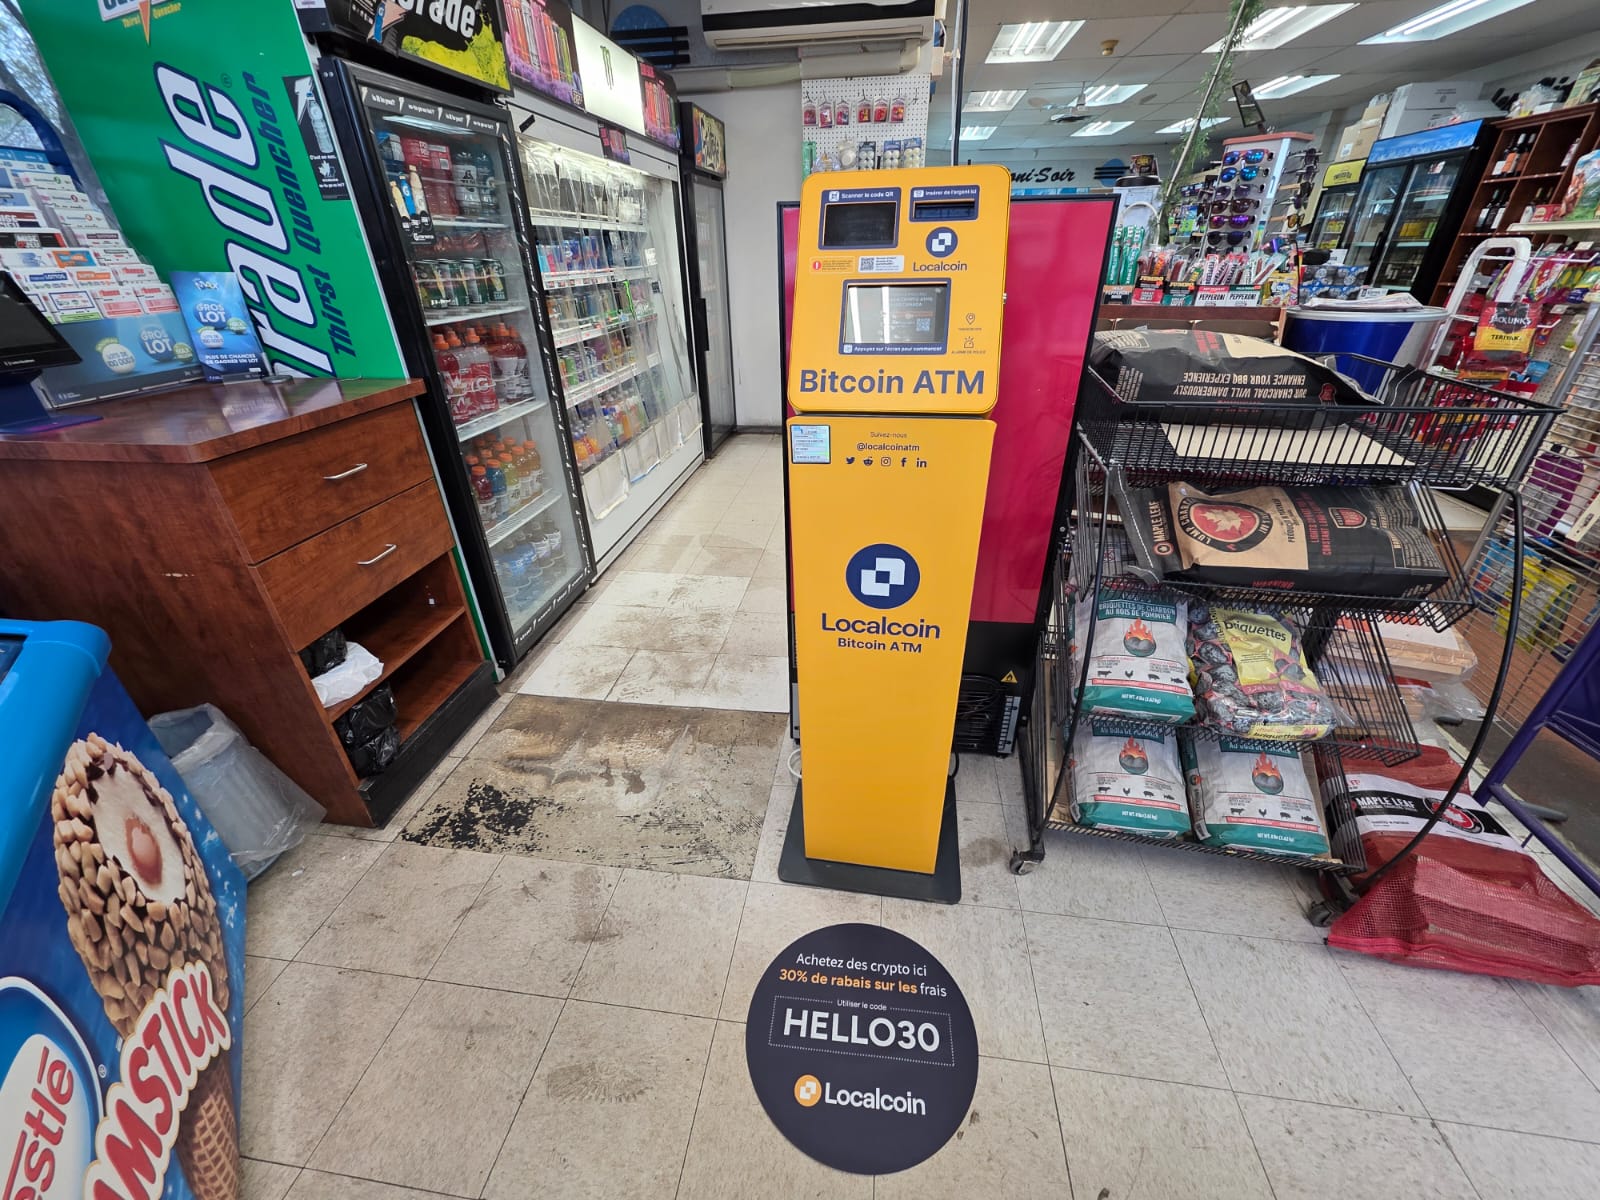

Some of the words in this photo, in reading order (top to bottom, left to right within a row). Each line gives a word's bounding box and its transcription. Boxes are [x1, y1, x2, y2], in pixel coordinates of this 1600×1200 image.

[242, 71, 321, 255] Quencher
[154, 61, 338, 378] rade
[912, 261, 968, 272] Localcoin
[1199, 293, 1226, 301] PEPPERONI
[196, 303, 225, 312] GROS
[306, 264, 357, 357] Thirst
[198, 311, 226, 323] LOT
[140, 328, 168, 341] GROS
[144, 338, 173, 354] LOT
[800, 368, 904, 393] Bitcoin
[912, 369, 985, 394] ATM
[1183, 372, 1231, 384] EXPERIENCE
[1232, 373, 1248, 385] BBQ
[1250, 373, 1271, 385] YOUR
[1272, 374, 1306, 386] ENHANCE
[1173, 384, 1229, 397] DANGEROUSLY
[1231, 386, 1252, 398] WILL
[1253, 386, 1293, 399] CHARCOAL
[870, 431, 907, 439] Suivez-nous
[856, 442, 920, 452] @localcoinatm
[1152, 519, 1165, 542] MAPLE
[821, 612, 941, 639] Localcoin
[1224, 621, 1287, 642] briquettes
[838, 638, 886, 651] Bitcoin
[890, 641, 922, 653] ATM
[1355, 796, 1390, 806] MAPLE
[1391, 798, 1416, 809] LEAF
[796, 953, 844, 969] Achetez
[846, 958, 868, 971] des
[870, 961, 910, 977] crypto
[913, 963, 927, 977] ici
[779, 969, 808, 983] 30%
[811, 972, 828, 985] de
[831, 974, 871, 989] rabais
[874, 980, 895, 992] sur
[898, 980, 918, 994] les
[920, 982, 947, 998] frais
[837, 999, 861, 1009] Utiliser
[861, 1000, 868, 1009] le
[869, 1002, 887, 1011] code
[783, 1007, 940, 1052] HELLO30
[93, 971, 226, 1200] MSTICK
[824, 1082, 926, 1116] Localcoin
